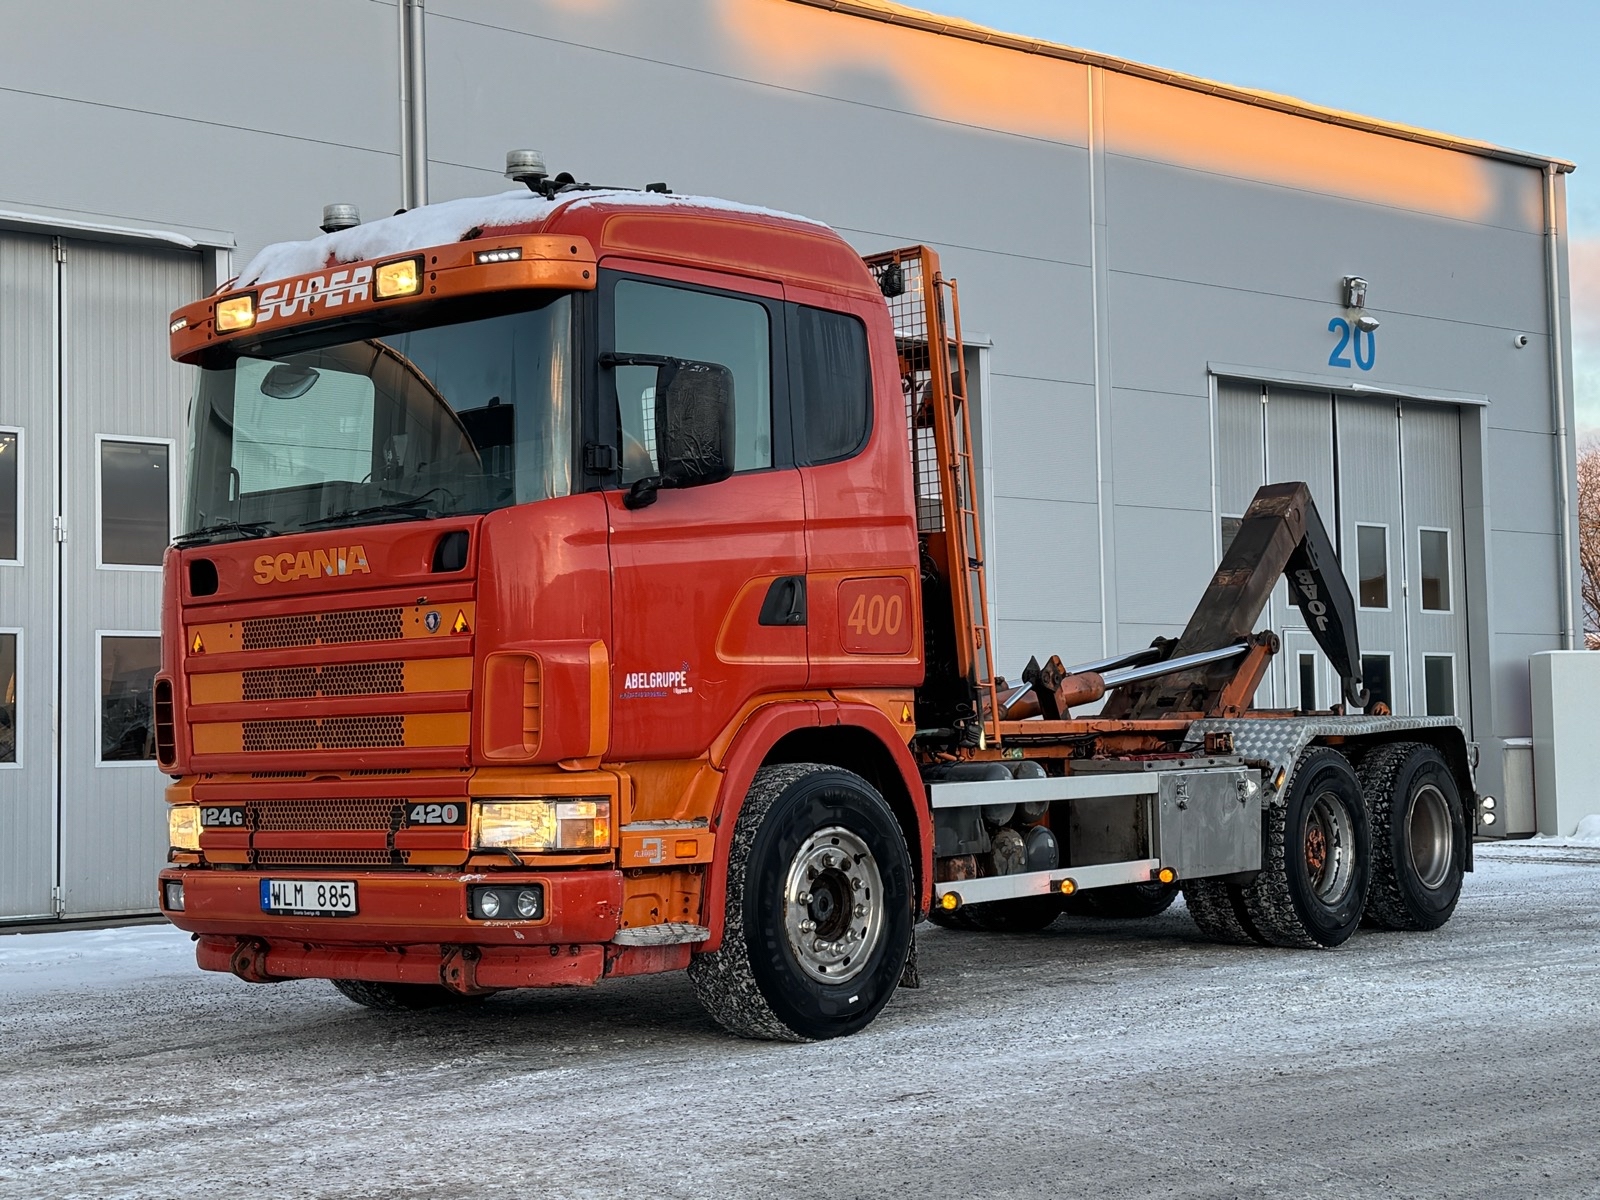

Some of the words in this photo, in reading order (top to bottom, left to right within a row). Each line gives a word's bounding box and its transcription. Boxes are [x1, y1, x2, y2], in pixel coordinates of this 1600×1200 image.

[256, 265, 373, 323] SUPER
[1328, 317, 1376, 371] 20
[253, 545, 371, 585] SCANIA
[847, 594, 903, 636] 400
[1295, 569, 1329, 632] JOAB
[624, 671, 687, 689] ABELGRUPPE
[201, 807, 244, 826] 124G
[410, 804, 459, 824] 420
[271, 883, 304, 907] WLM
[317, 884, 351, 909] 885
